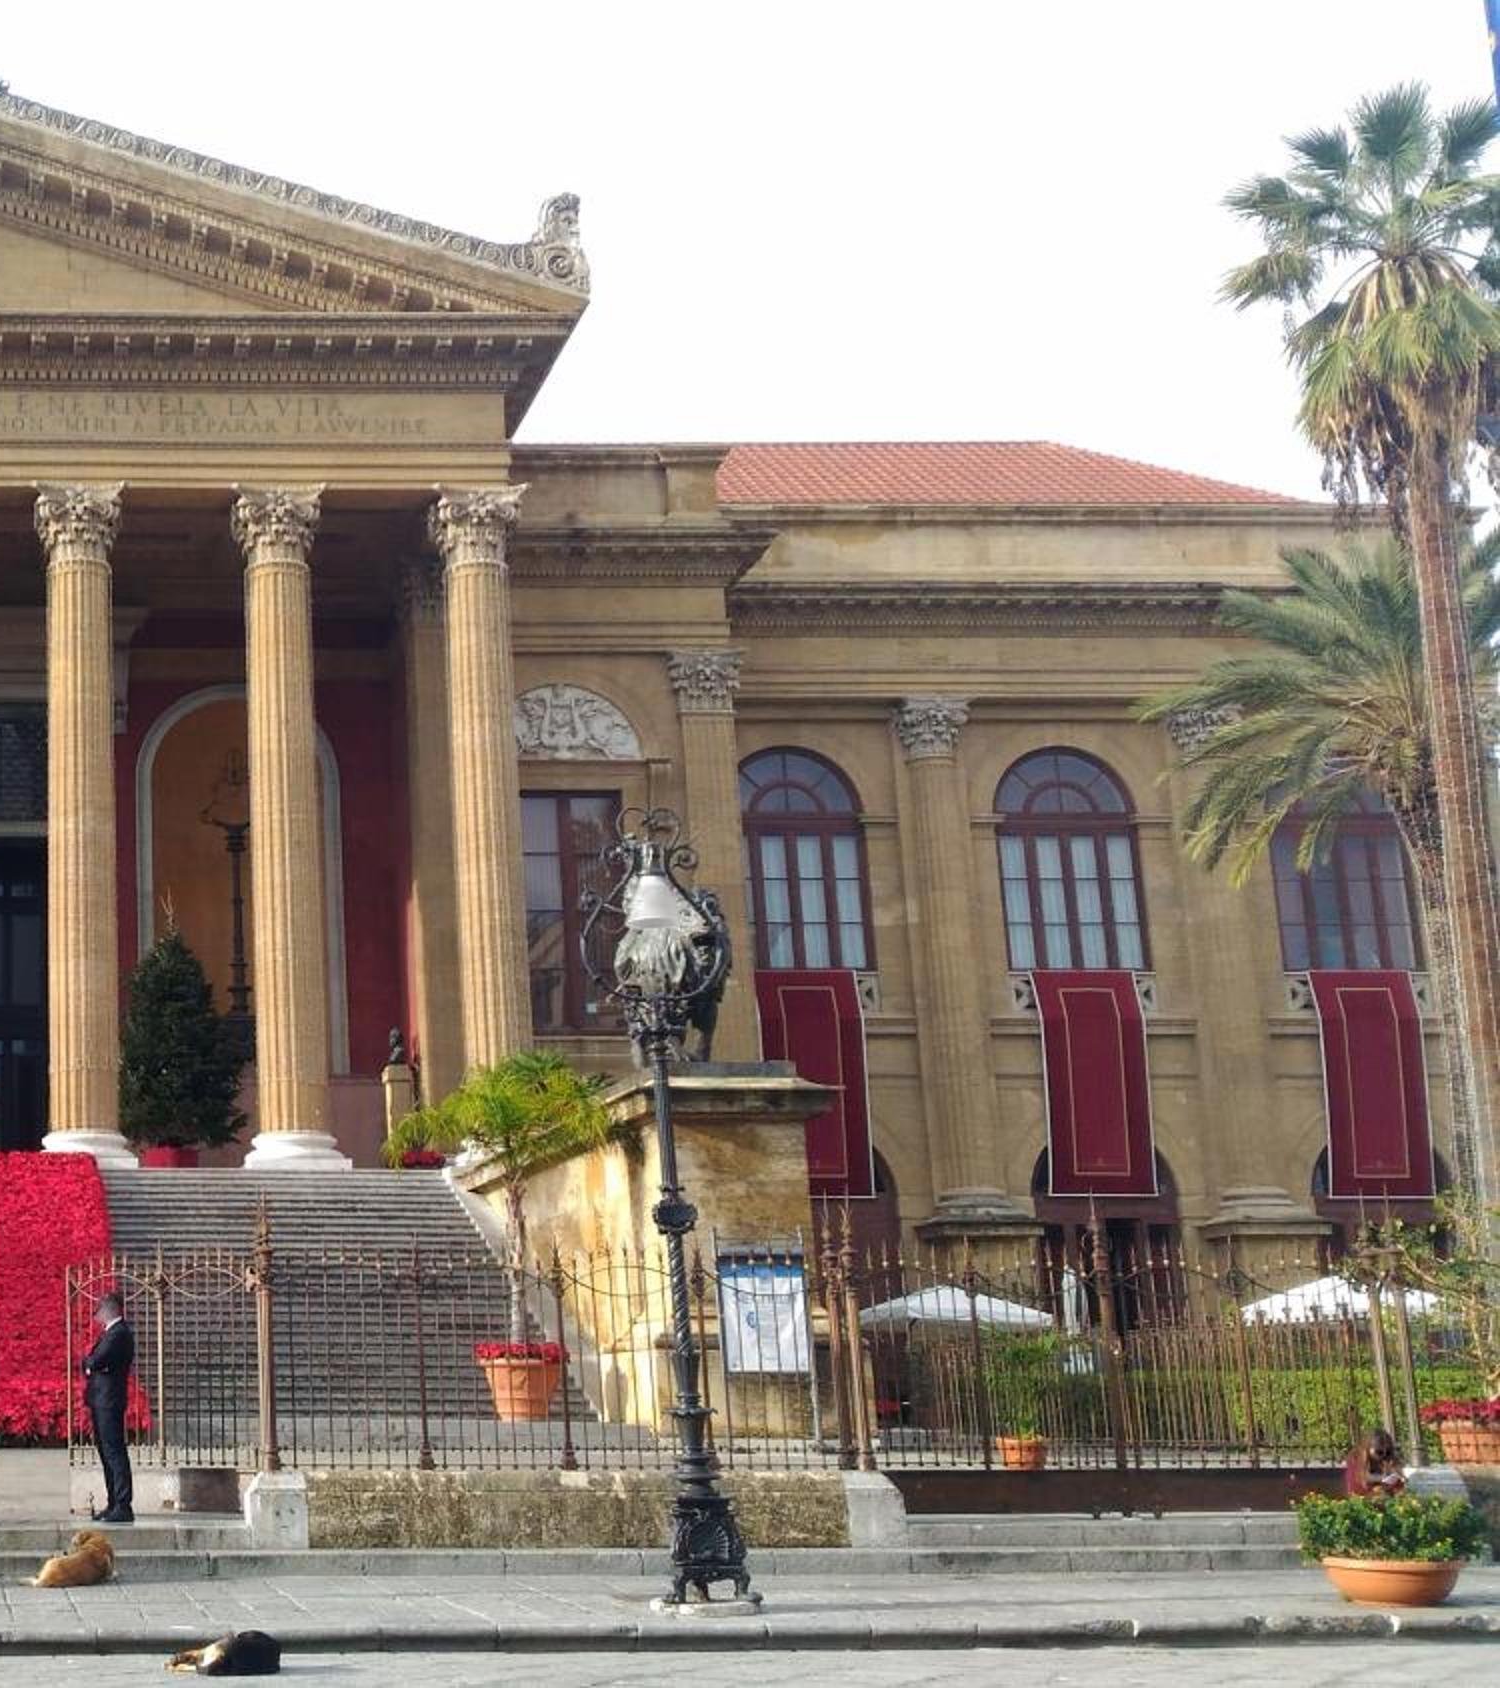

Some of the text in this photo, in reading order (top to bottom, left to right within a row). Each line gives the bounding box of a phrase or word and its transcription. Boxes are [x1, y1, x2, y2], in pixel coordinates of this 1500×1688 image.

[47, 394, 84, 416] NE
[104, 395, 208, 416] RIVELA
[227, 396, 259, 417] LA
[275, 397, 345, 417] VITA
